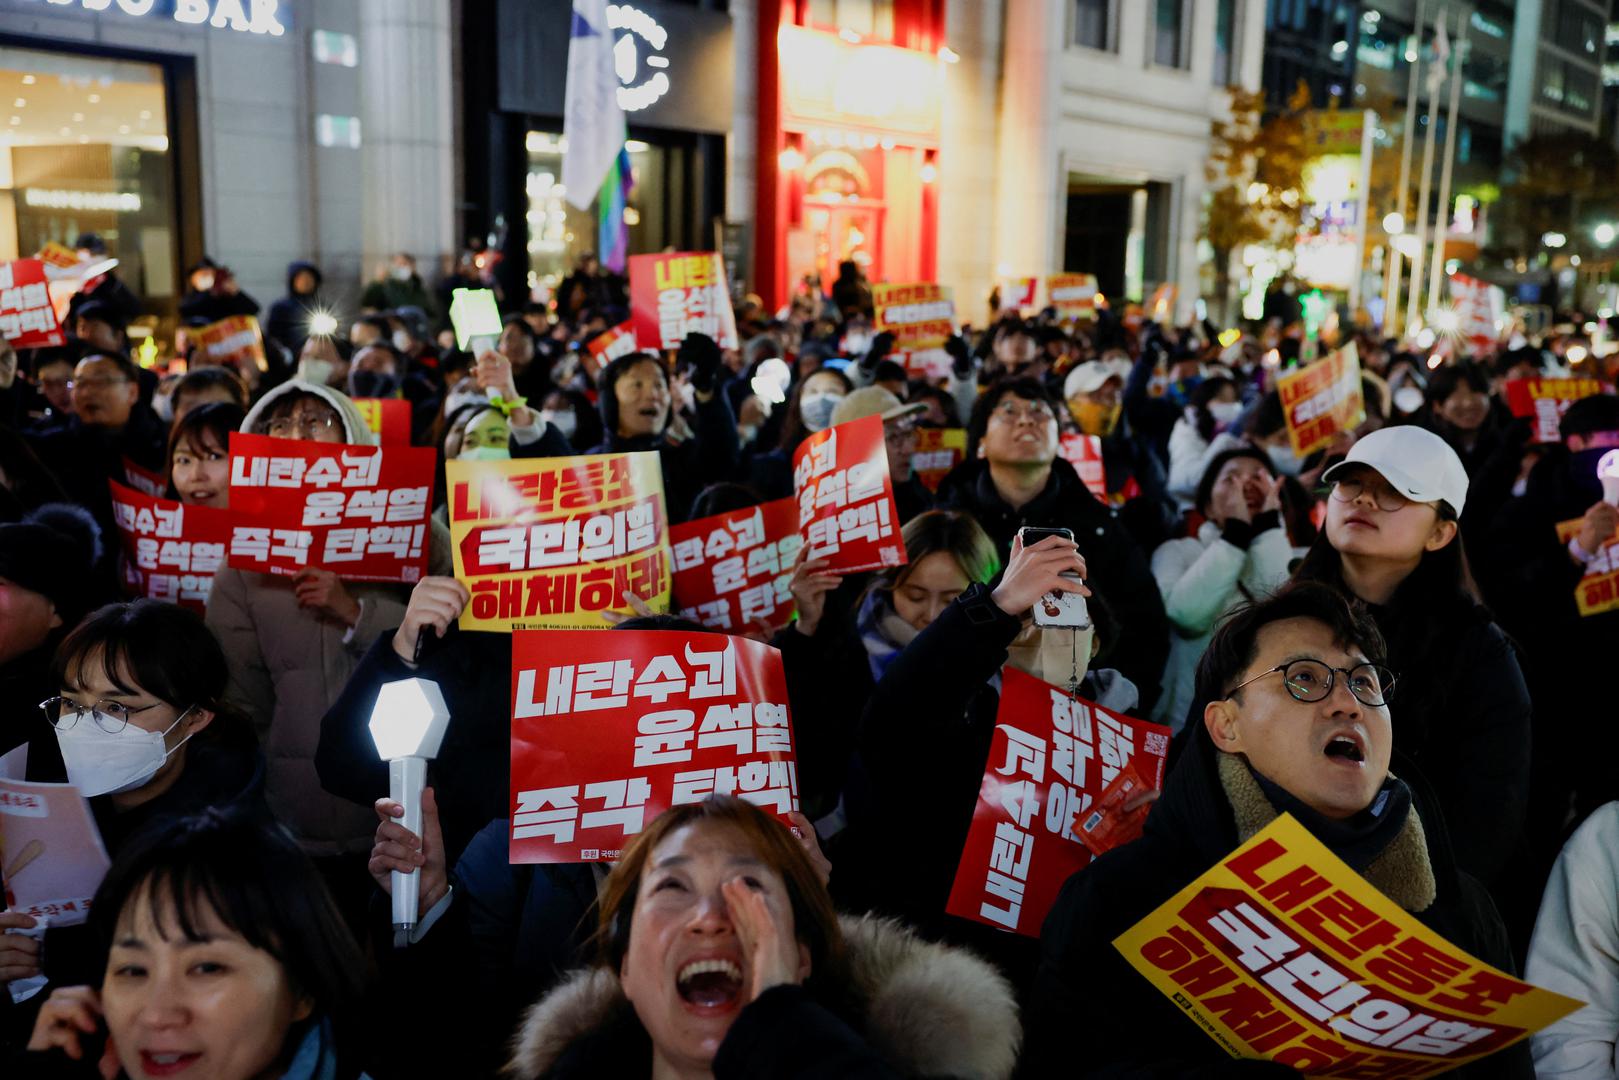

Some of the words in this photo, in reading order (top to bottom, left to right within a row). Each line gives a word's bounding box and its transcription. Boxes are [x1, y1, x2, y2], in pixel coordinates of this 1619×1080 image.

[231, 446, 383, 489] 내란수괴
[453, 455, 637, 522] 내란동조
[302, 486, 429, 526] 윤석열
[478, 503, 656, 571] 국민의힘
[668, 506, 766, 574] 란수괴
[806, 498, 893, 561] 탄핵!
[137, 538, 225, 573] 윤석열
[230, 526, 314, 565] 즉각
[323, 524, 426, 564] 탄핵!
[471, 551, 667, 620] 해체하라!
[514, 634, 736, 719] 내란수괴
[633, 702, 791, 768] 윤석열
[1046, 689, 1094, 845] 윤석열
[513, 776, 652, 844] 즉각
[672, 760, 799, 815] 탄핵!
[979, 723, 1047, 930] 내란수괴
[1224, 838, 1536, 1016] 내란동조
[1207, 902, 1496, 1055] 국민의힘
